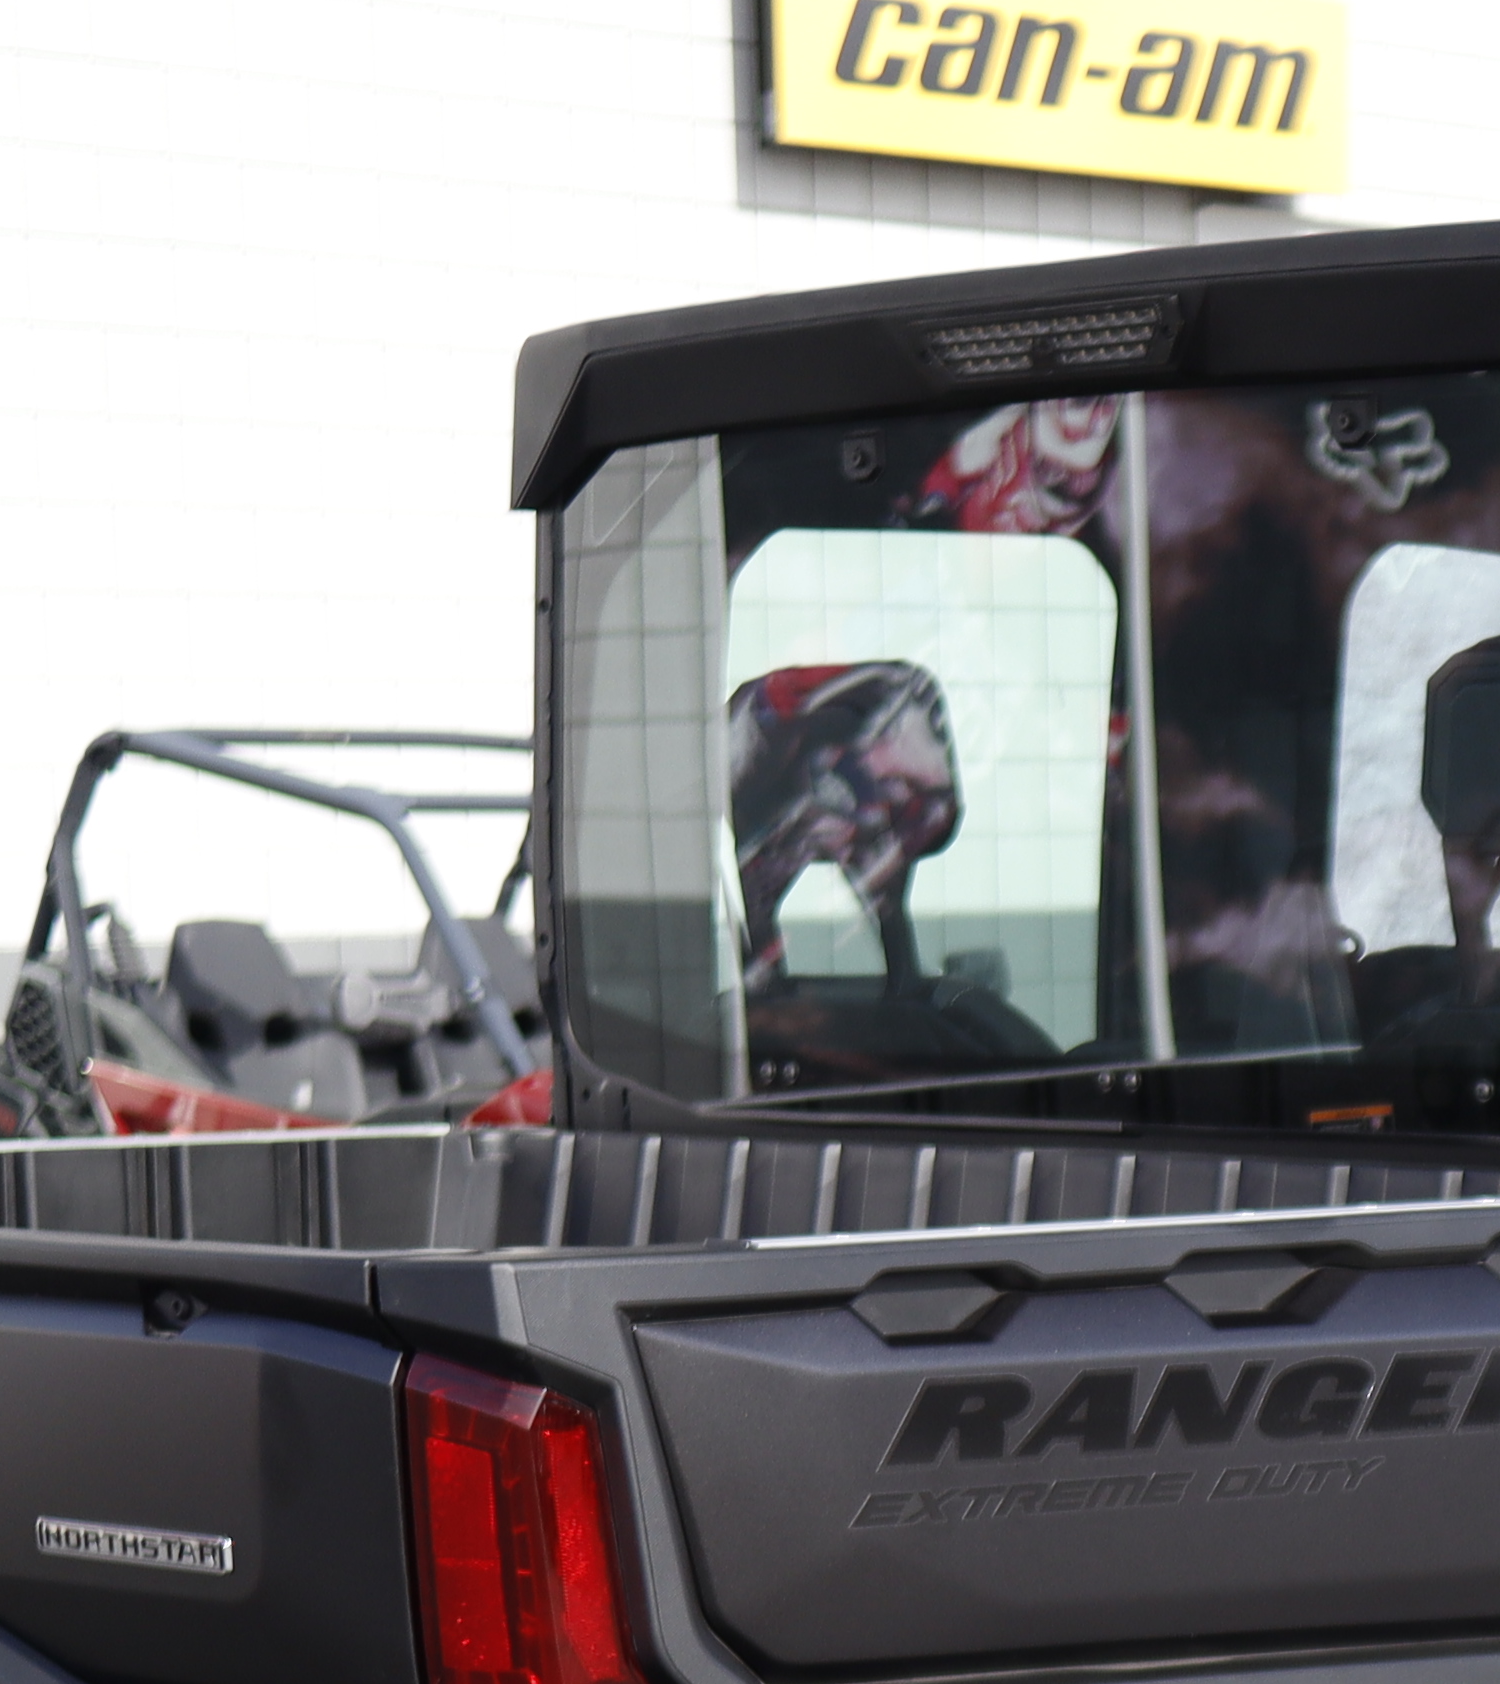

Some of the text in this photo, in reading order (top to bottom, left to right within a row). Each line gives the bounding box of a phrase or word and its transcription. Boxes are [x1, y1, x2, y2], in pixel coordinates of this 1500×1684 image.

[834, 0, 1315, 132] can-am
[849, 1456, 1387, 1529] EXTREME DUTY
[45, 1524, 219, 1567] NORTHSTAR
